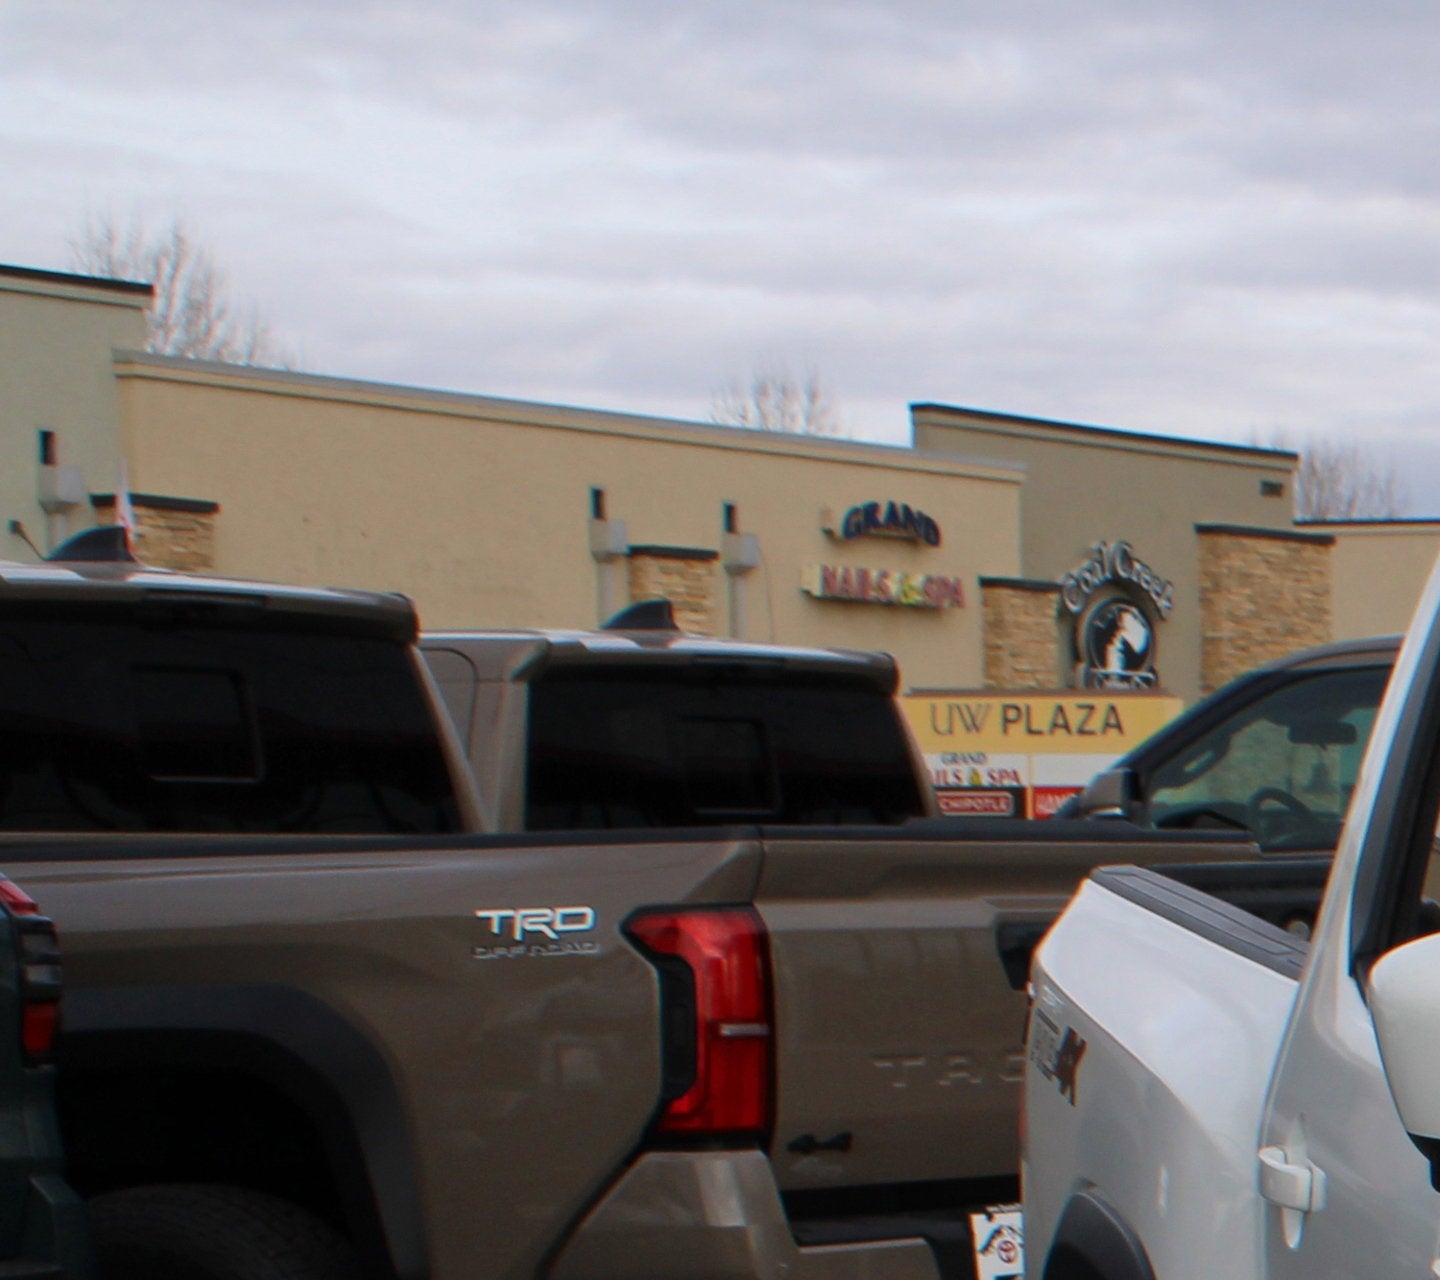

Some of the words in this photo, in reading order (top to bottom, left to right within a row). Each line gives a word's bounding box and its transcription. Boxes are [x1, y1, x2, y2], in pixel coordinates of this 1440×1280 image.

[842, 500, 941, 547] GRAND
[820, 563, 893, 605] NAILS
[923, 573, 966, 609] SPA
[1060, 541, 1113, 614] Coal
[1112, 540, 1175, 613] Creek
[930, 703, 990, 736] UW
[1001, 703, 1125, 736] PLAZA
[986, 767, 1020, 786] SPA
[474, 906, 596, 941] TRD
